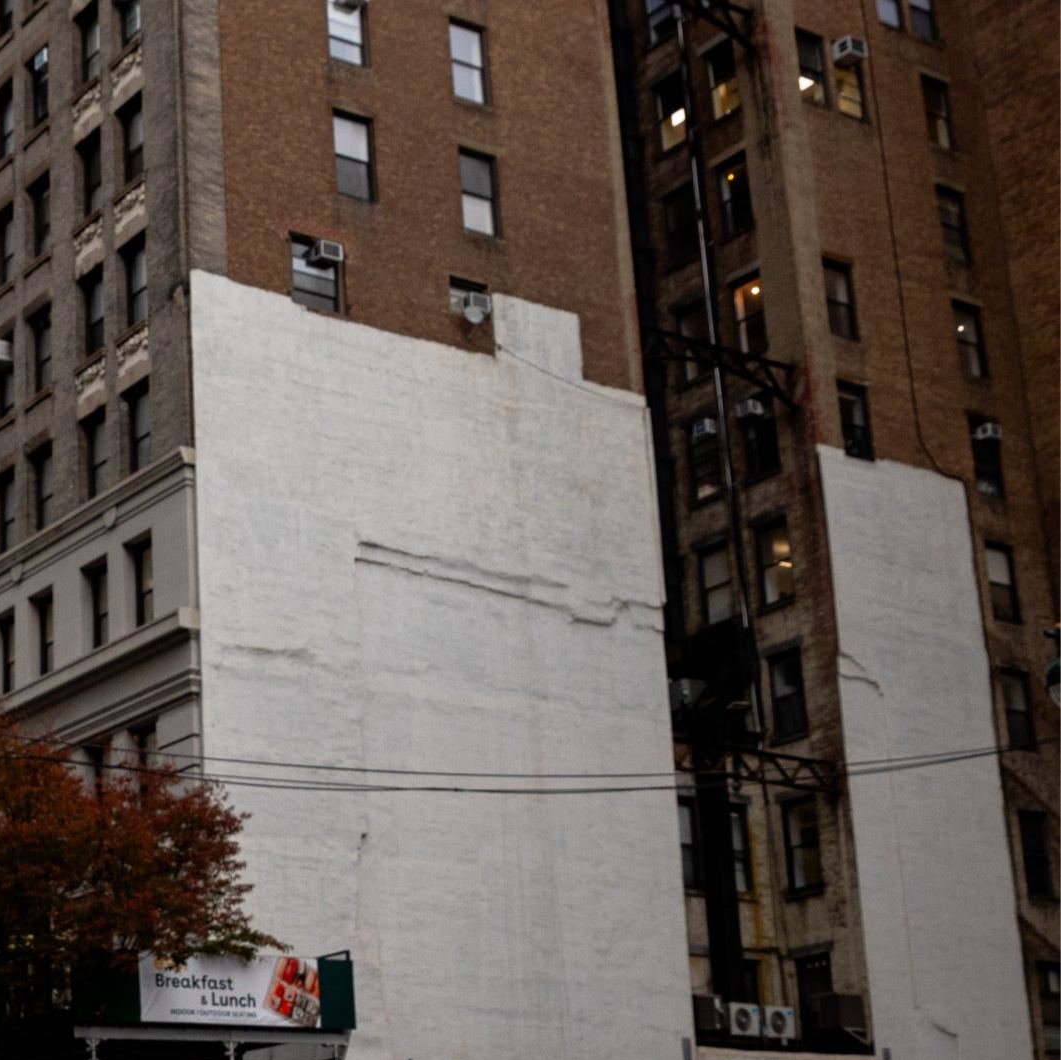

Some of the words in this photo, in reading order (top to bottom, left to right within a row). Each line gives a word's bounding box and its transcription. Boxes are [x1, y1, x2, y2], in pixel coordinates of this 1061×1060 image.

[155, 974, 234, 991] Breakfast
[200, 994, 207, 1005] &
[211, 992, 256, 1008] Lunch
